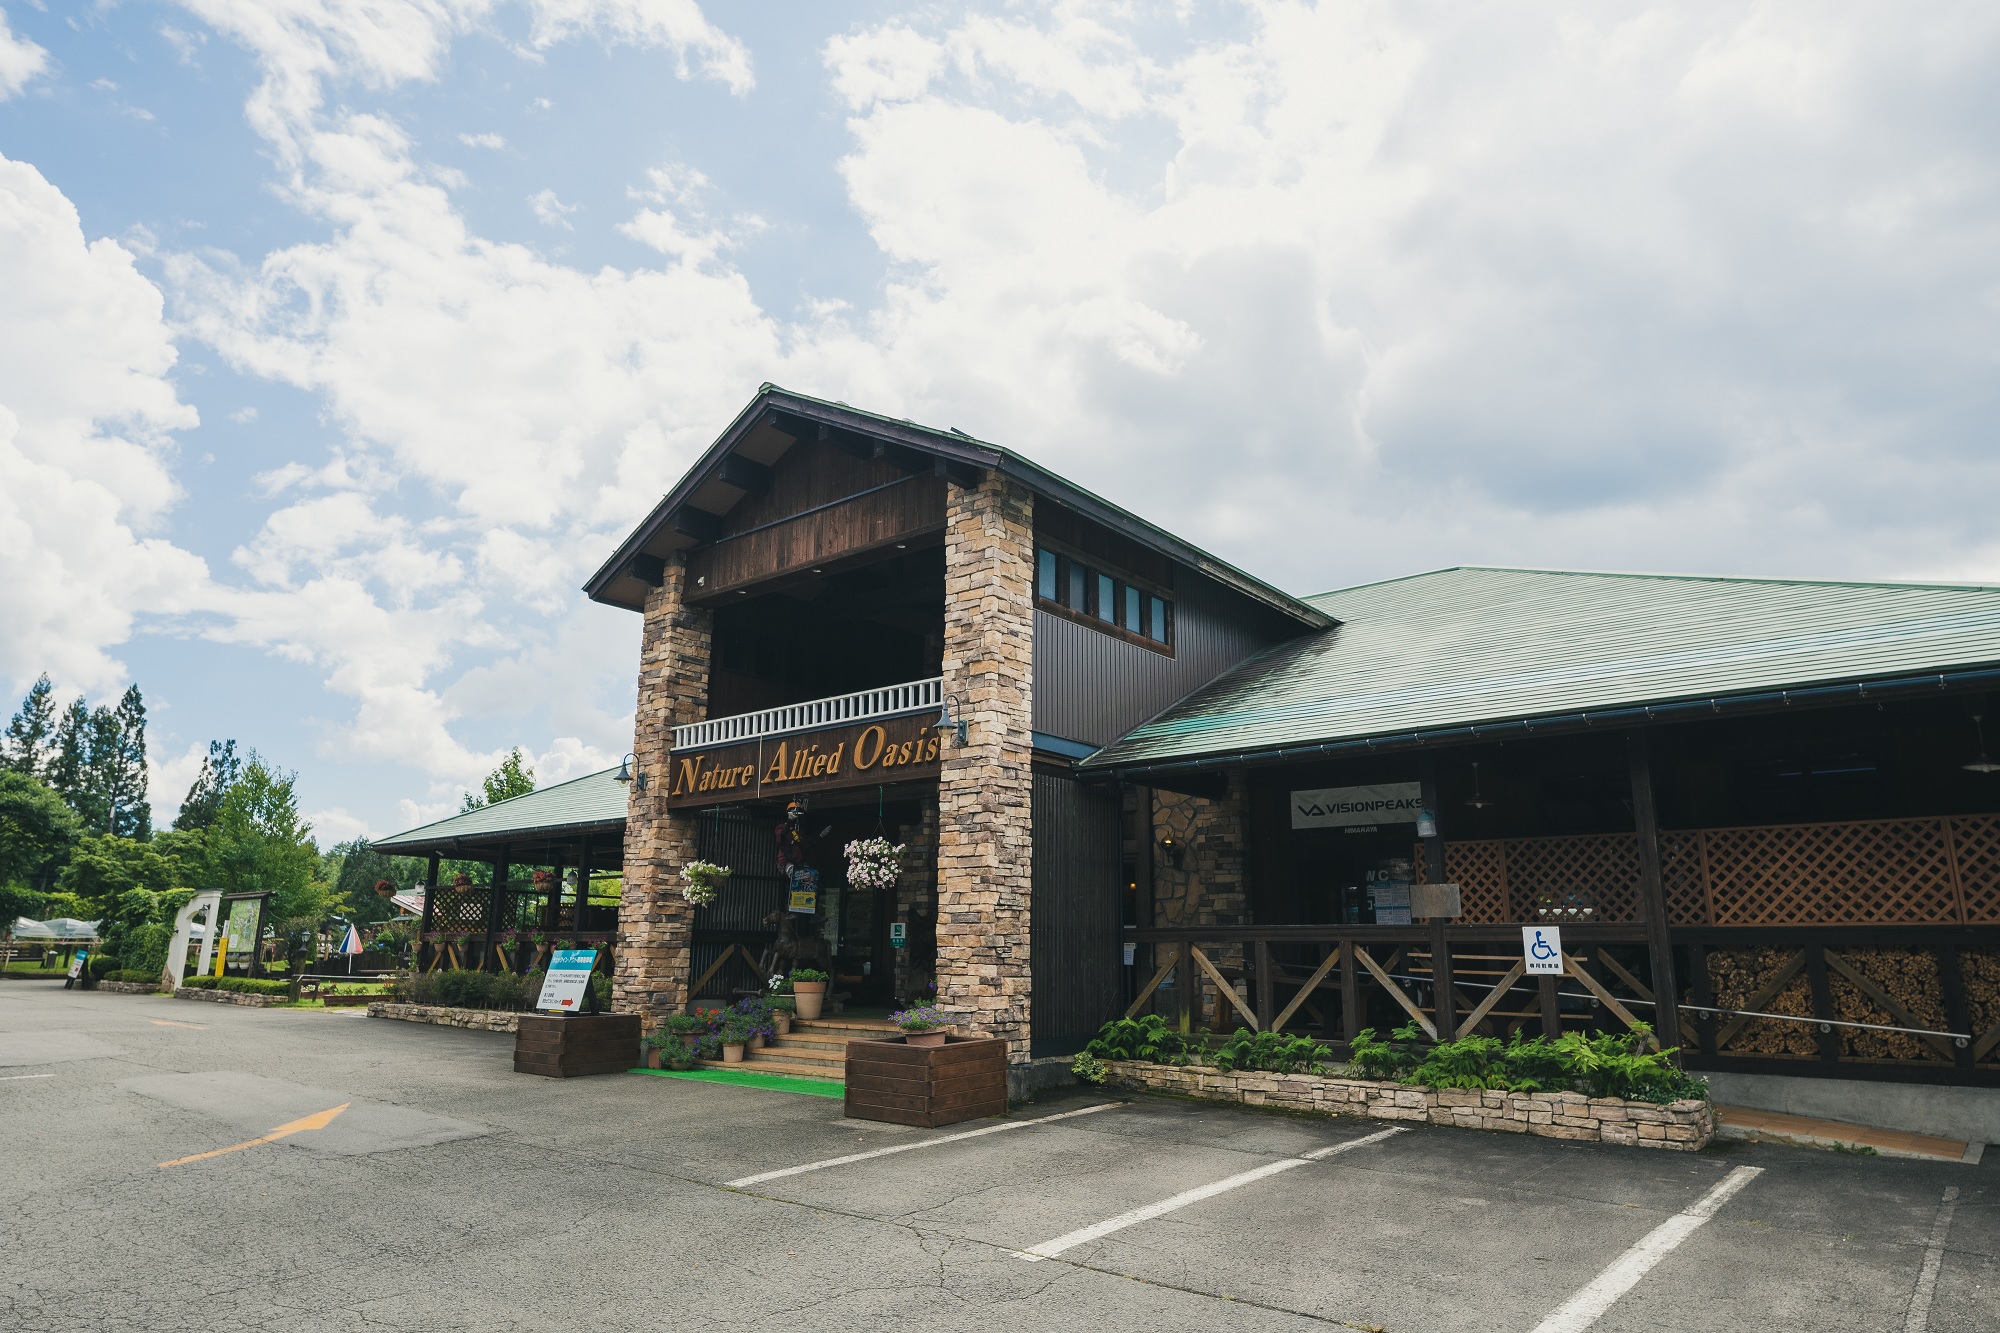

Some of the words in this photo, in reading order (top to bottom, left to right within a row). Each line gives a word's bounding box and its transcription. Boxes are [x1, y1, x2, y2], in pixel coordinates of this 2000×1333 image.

[671, 756, 755, 796] Nature
[761, 741, 845, 784] Allied
[853, 725, 940, 770] Oasis
[1326, 798, 1422, 814] VISIONPEAKS
